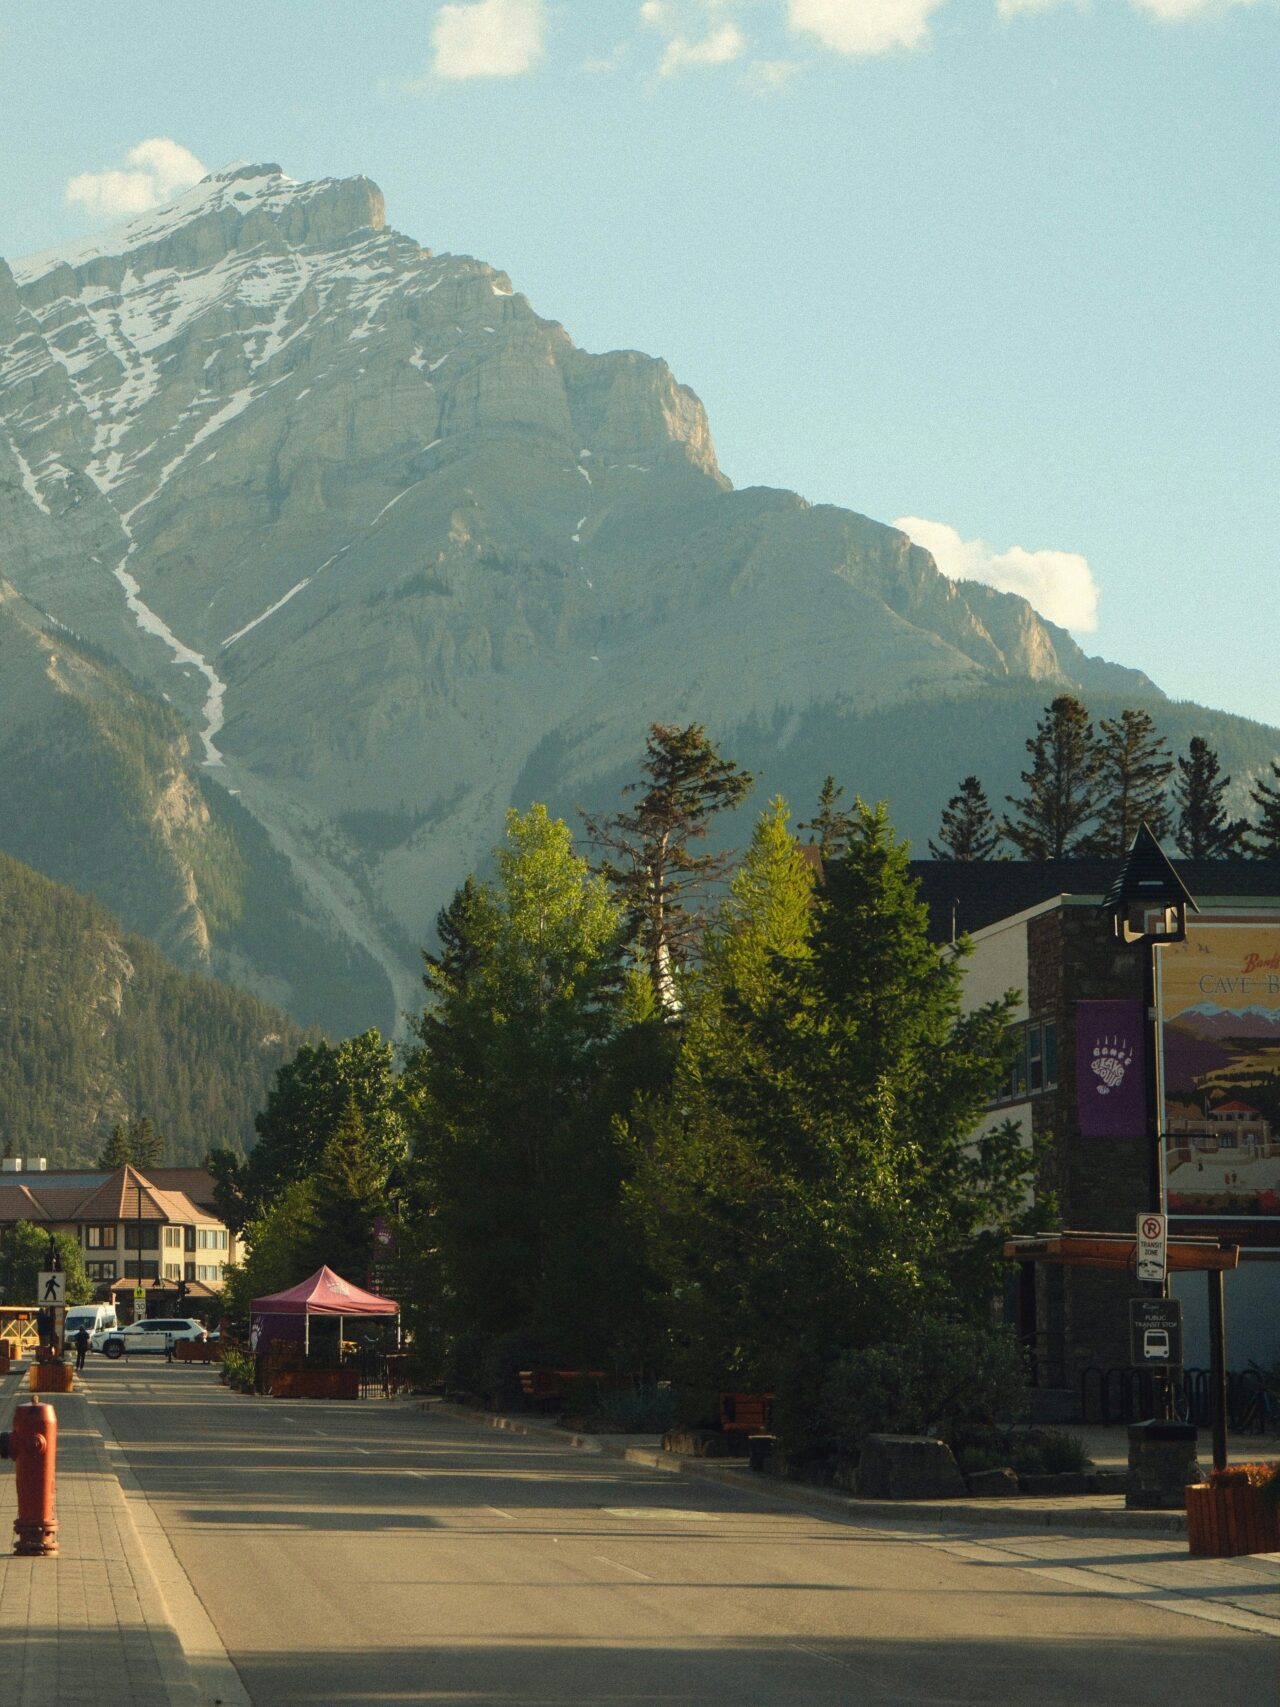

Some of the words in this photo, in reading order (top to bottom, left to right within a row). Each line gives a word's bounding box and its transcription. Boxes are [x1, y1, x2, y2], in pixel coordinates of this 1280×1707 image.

[1199, 974, 1250, 994] CAVE
[1140, 1241, 1163, 1249] TRANSIT
[135, 1303, 146, 1311] 30
